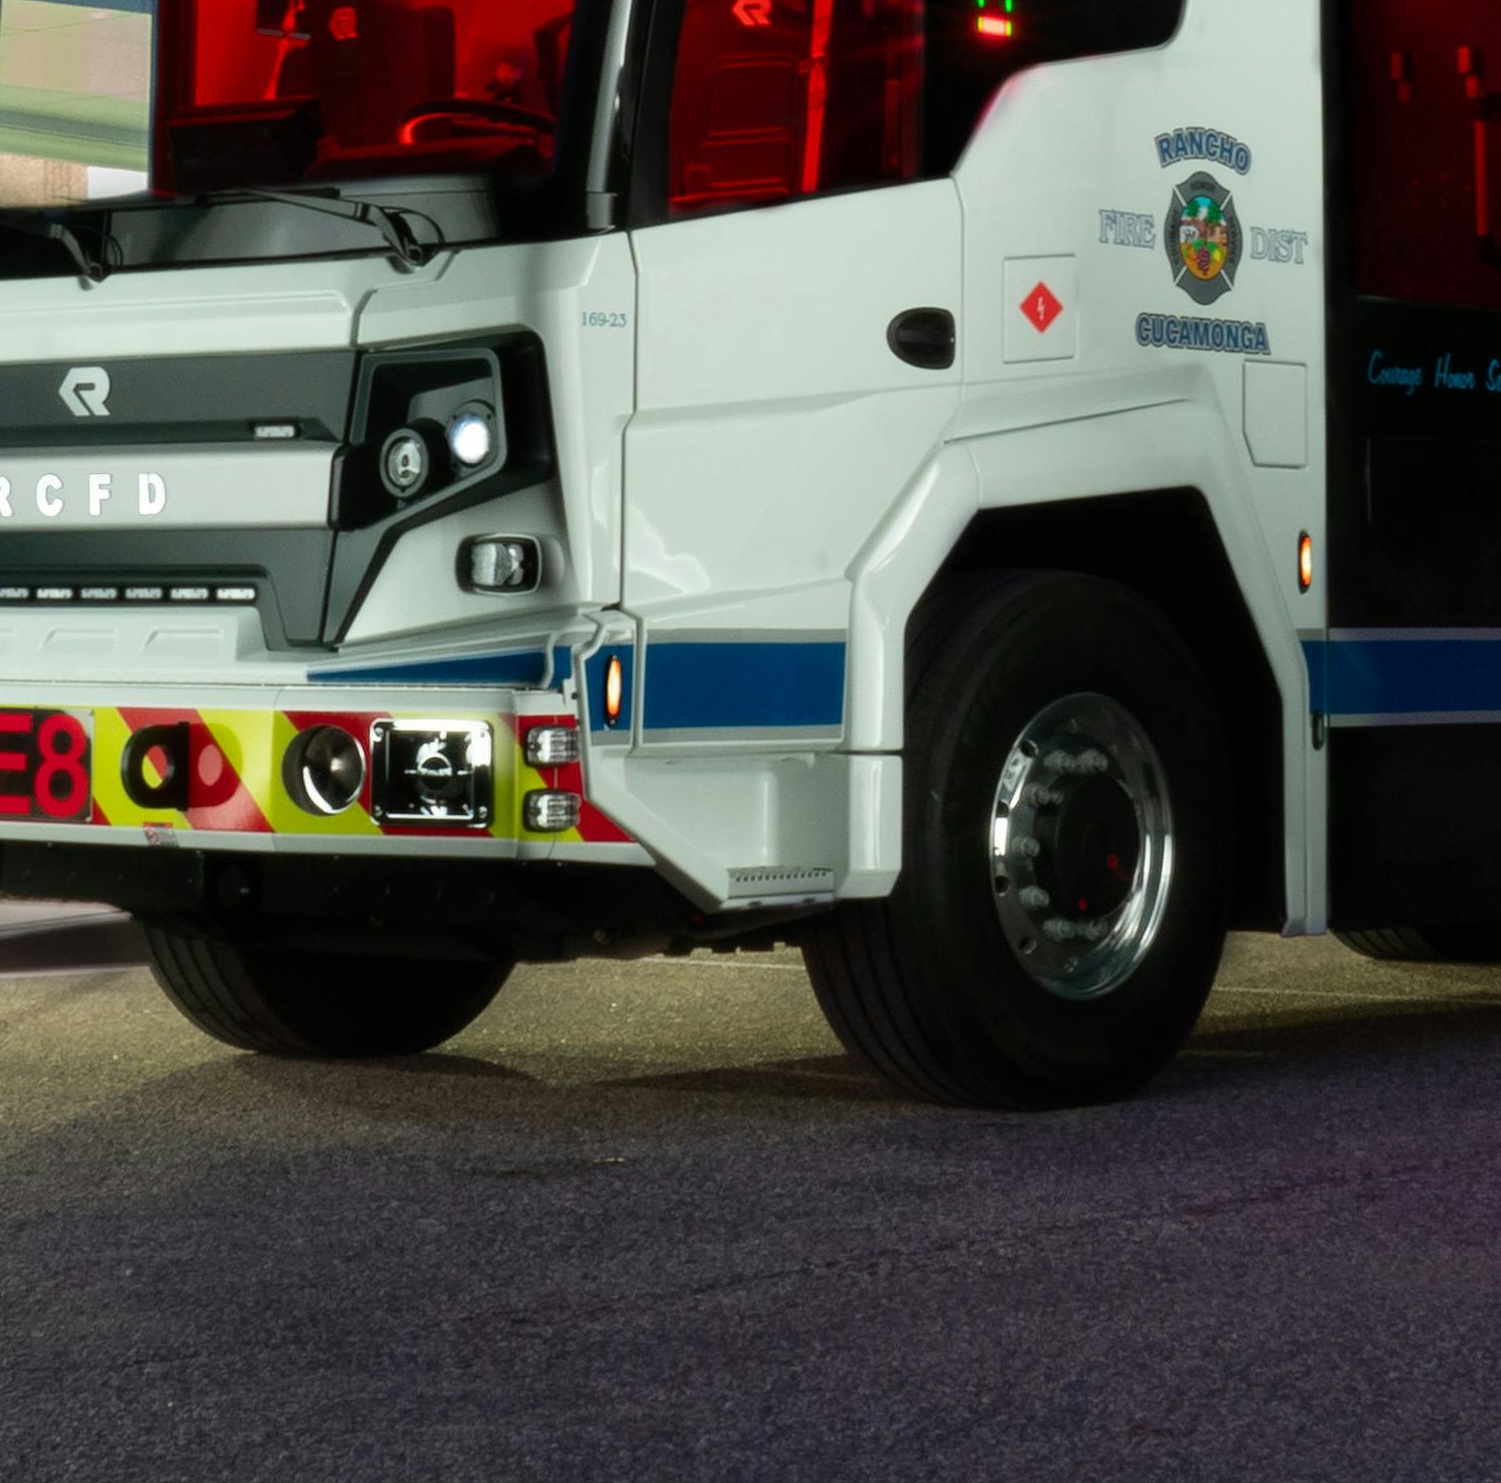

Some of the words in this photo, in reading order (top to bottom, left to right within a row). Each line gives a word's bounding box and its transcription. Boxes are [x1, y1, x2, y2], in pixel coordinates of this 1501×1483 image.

[1154, 126, 1252, 175] RANCHO
[1098, 209, 1156, 250] FIRE
[1249, 226, 1308, 265] DIST
[581, 311, 628, 328] 169-23
[1135, 312, 1271, 356] CUCAMONGA
[1368, 349, 1423, 396] Courage
[1434, 353, 1476, 389] Honor
